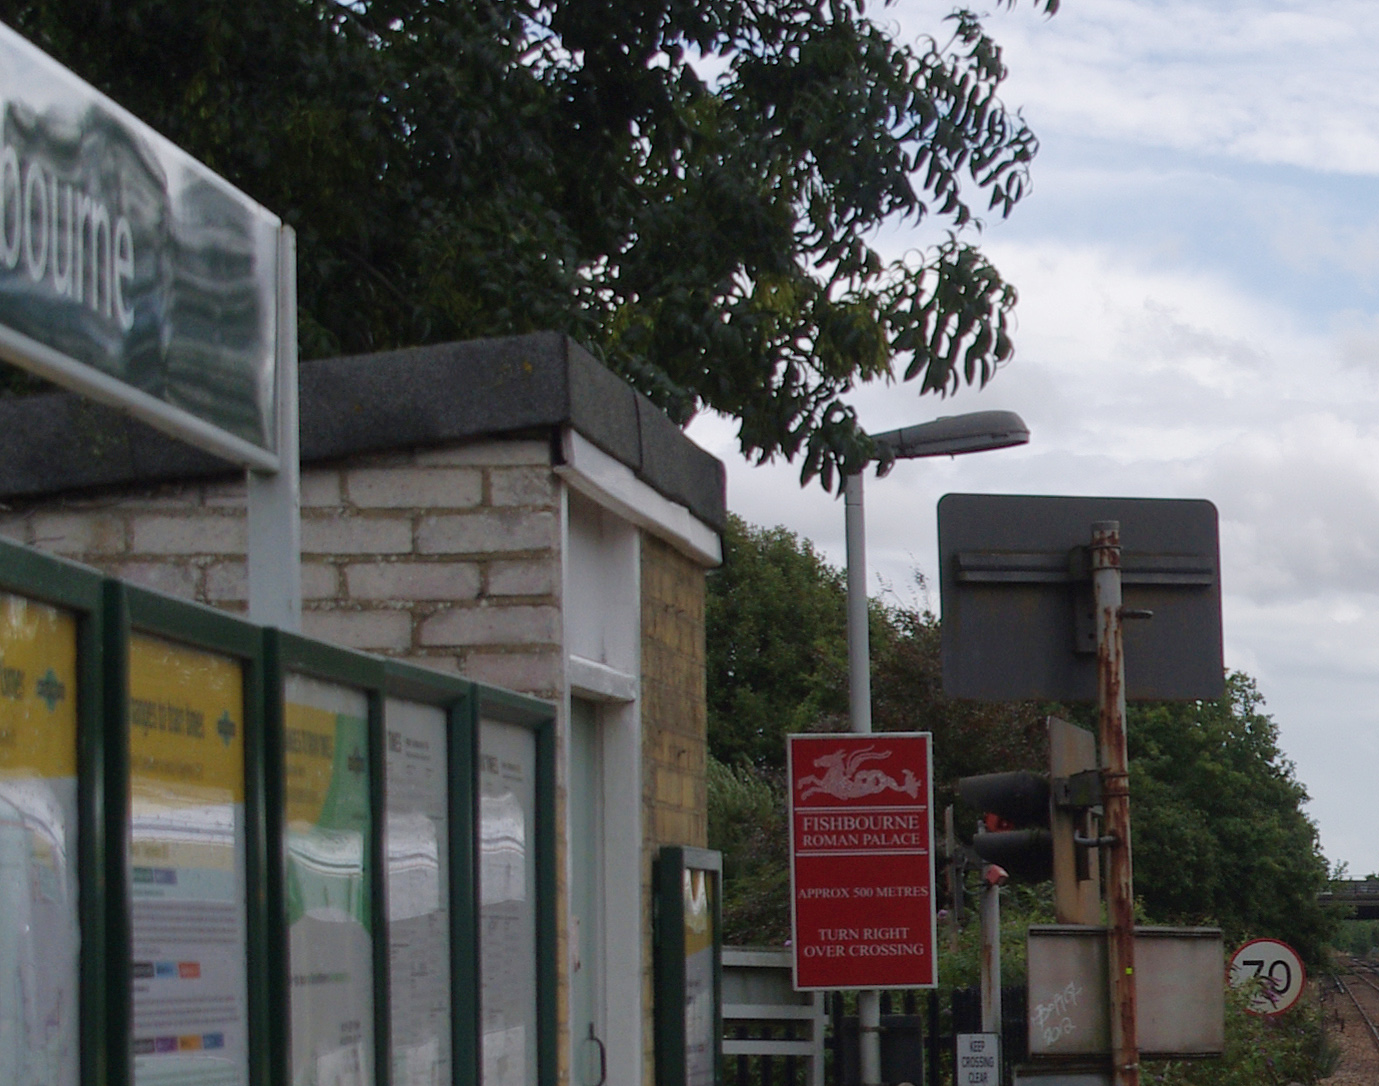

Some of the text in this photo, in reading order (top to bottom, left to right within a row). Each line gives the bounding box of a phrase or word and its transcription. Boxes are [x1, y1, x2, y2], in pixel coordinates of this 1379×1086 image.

[803, 815, 919, 832] FISHBOURNE
[803, 833, 920, 847] ROMAN PALACE
[798, 885, 929, 899] APPROX 500 METRES
[818, 927, 910, 941] TURN RIGHT
[804, 943, 924, 958] OVER CROSSING
[1242, 960, 1291, 995] 70
[970, 1040, 985, 1052] KEEP
[961, 1056, 994, 1068] CROSSING
[968, 1072, 989, 1084] CLEAR
